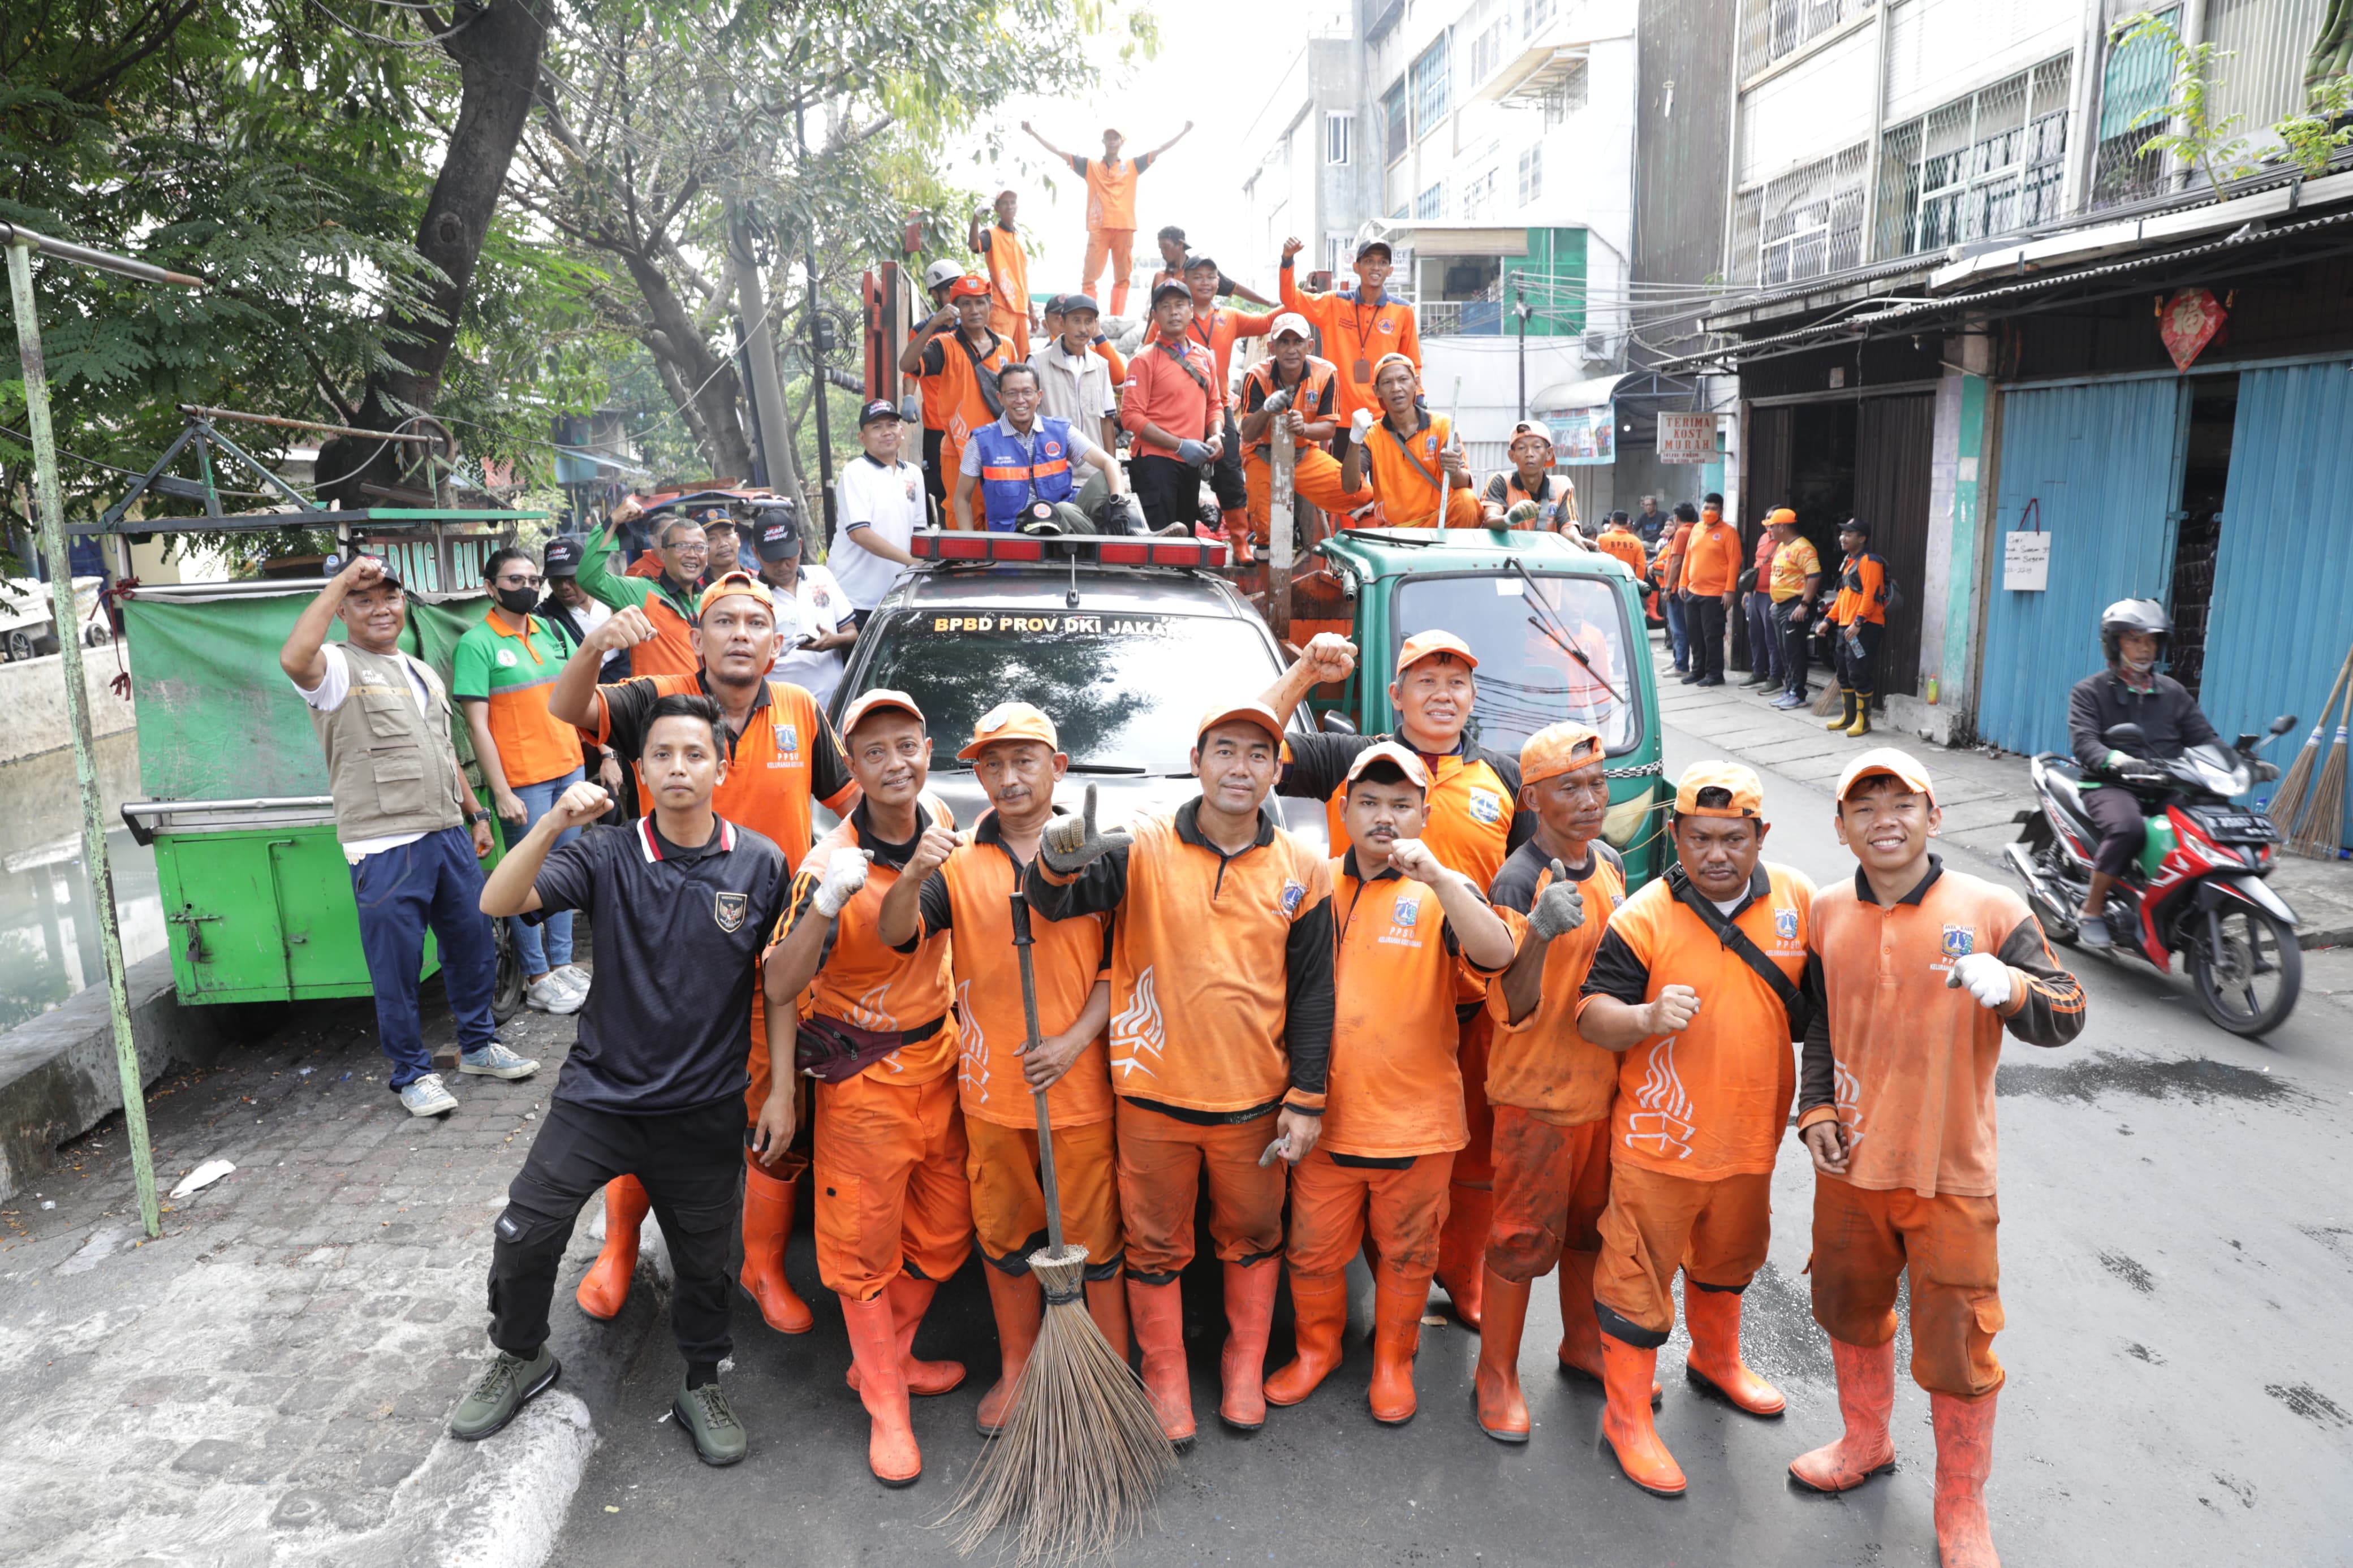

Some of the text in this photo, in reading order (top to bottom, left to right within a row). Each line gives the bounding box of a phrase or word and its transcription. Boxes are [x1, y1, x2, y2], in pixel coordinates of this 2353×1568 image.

[1666, 417, 1710, 427] TERIMA
[1674, 429, 1703, 439] KOST
[1665, 439, 1709, 450] MURAH
[359, 541, 438, 593] RANG
[934, 617, 993, 632] BPBD
[999, 617, 1058, 632] PROV
[1065, 619, 1101, 633] DKI
[1389, 926, 1415, 939] PPSU
[1776, 940, 1800, 949] PPSU
